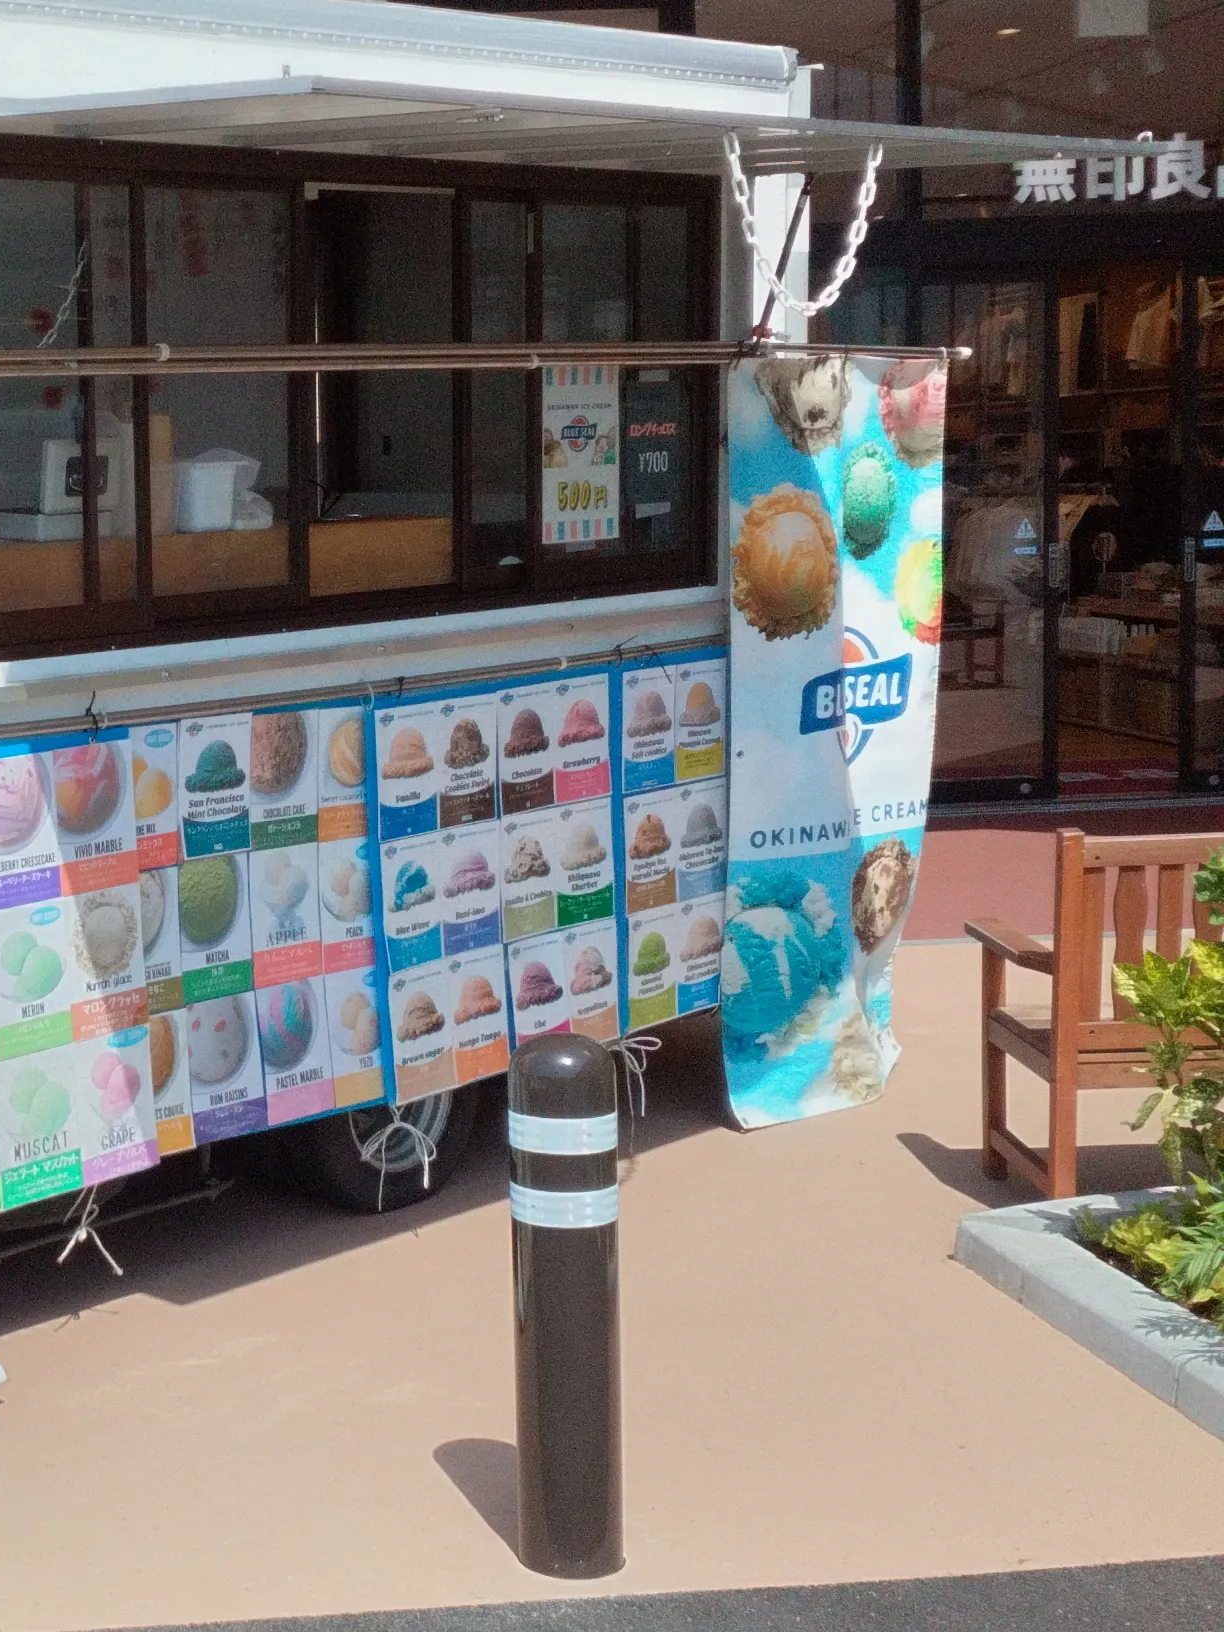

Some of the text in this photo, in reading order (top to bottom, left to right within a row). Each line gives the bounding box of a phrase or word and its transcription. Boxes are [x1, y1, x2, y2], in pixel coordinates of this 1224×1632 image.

[1013, 132, 1224, 203] 無印良
[638, 450, 669, 474] ¥700
[557, 479, 608, 512] 500円
[845, 672, 903, 710] SEAL
[188, 793, 245, 809] San Francisco
[262, 803, 307, 819] CHOCOLATE CAKE
[872, 799, 928, 822] CREAM
[187, 804, 247, 820] Mint Chocolate
[73, 837, 123, 859] VIVID MARBLE
[20, 852, 56, 868] CHEESECAKE
[266, 926, 308, 947] APPLE
[345, 925, 364, 938] PEACH
[205, 950, 231, 965] MATCHA
[21, 1002, 45, 1019] MERON
[82, 991, 141, 1015] マロングラッセ
[401, 1046, 445, 1066] Brown sugar
[276, 1066, 324, 1091] PASTEL MARBLE
[209, 1086, 249, 1106] RUM RAISINS
[13, 1131, 70, 1162] MUSCAT
[101, 1126, 137, 1151] GRAPE
